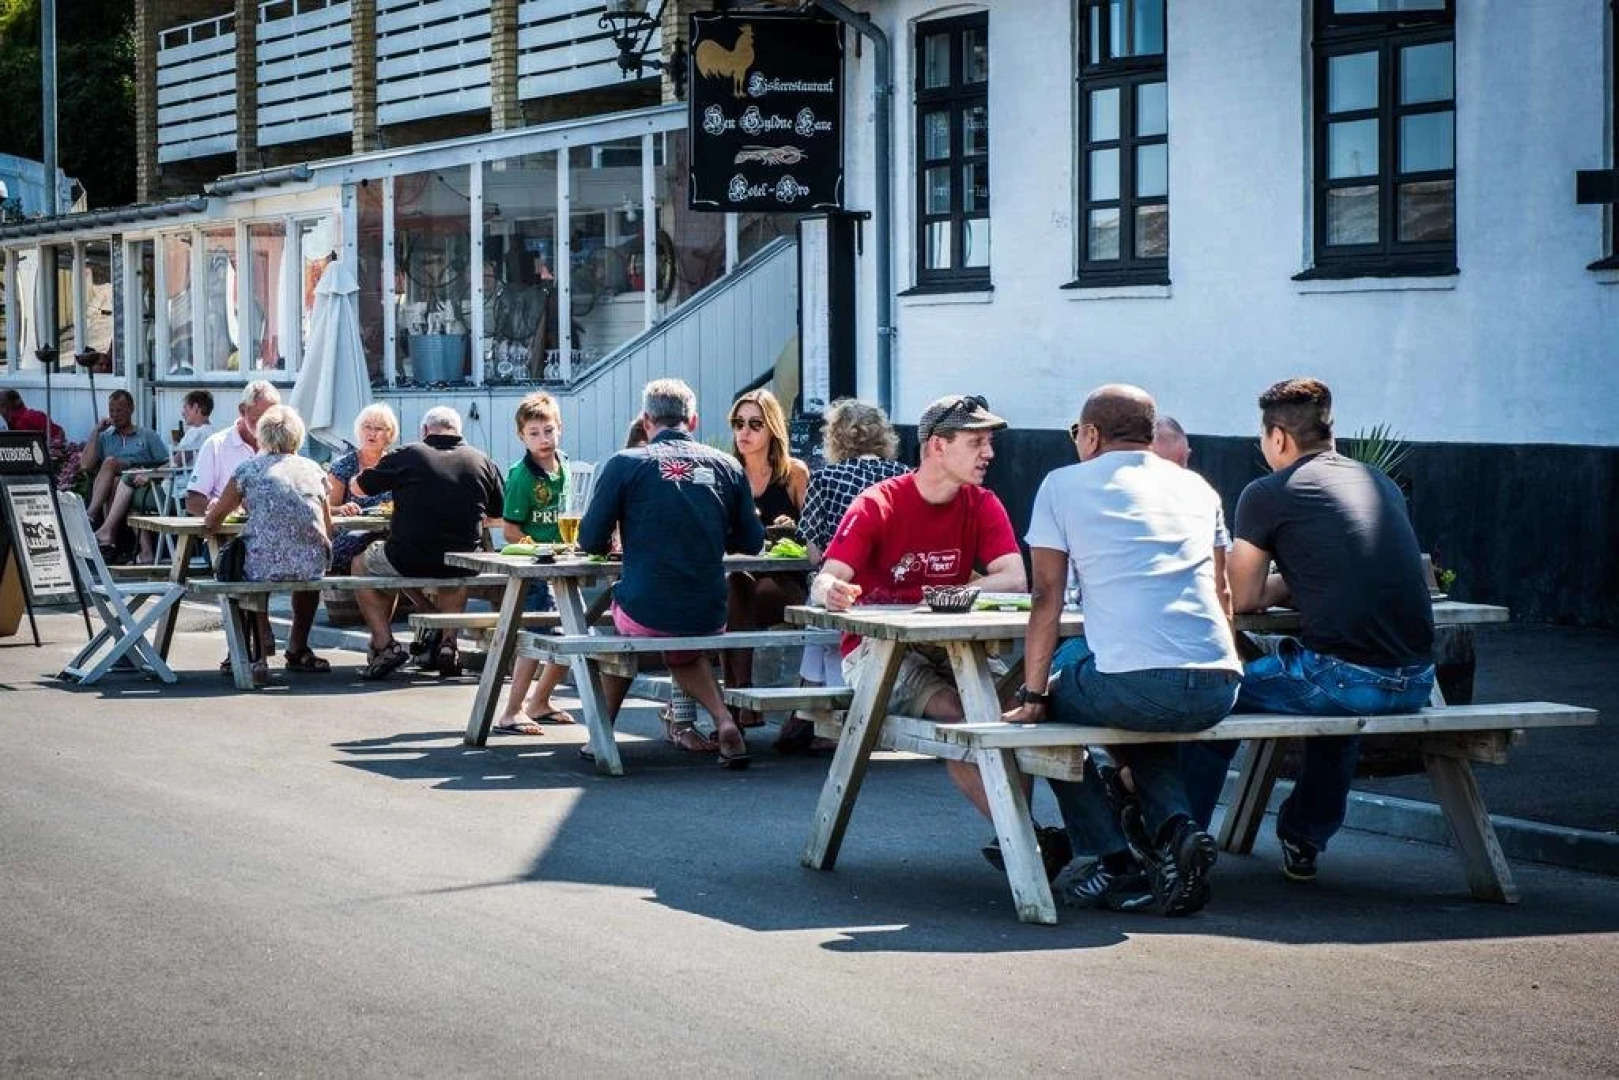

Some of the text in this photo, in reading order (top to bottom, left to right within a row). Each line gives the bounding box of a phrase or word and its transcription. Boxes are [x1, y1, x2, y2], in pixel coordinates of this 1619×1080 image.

[748, 71, 833, 98] Fiskerestaurant
[703, 104, 832, 137] Den Gyldne Hane
